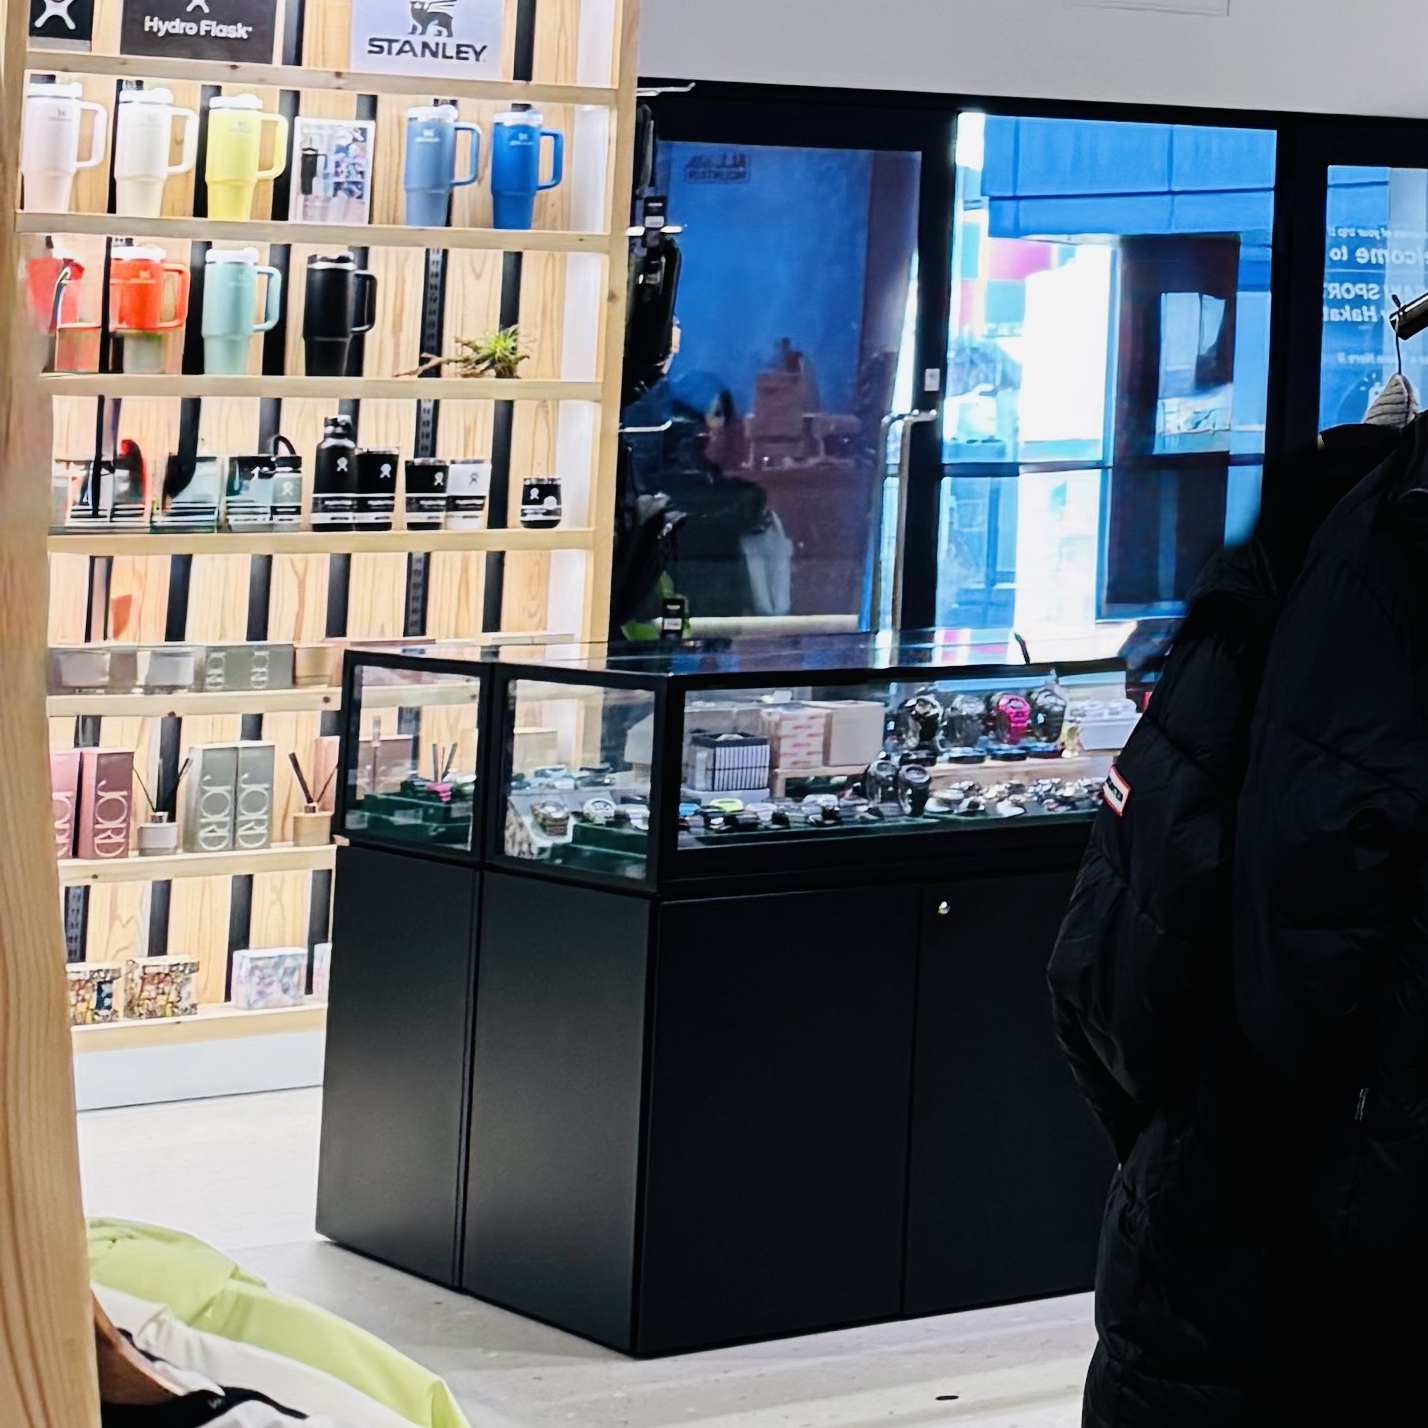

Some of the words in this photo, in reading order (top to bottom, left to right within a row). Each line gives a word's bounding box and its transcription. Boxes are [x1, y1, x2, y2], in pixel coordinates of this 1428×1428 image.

[143, 15, 199, 39] Hydro
[200, 19, 249, 40] Flask
[367, 37, 487, 62] STANLEY
